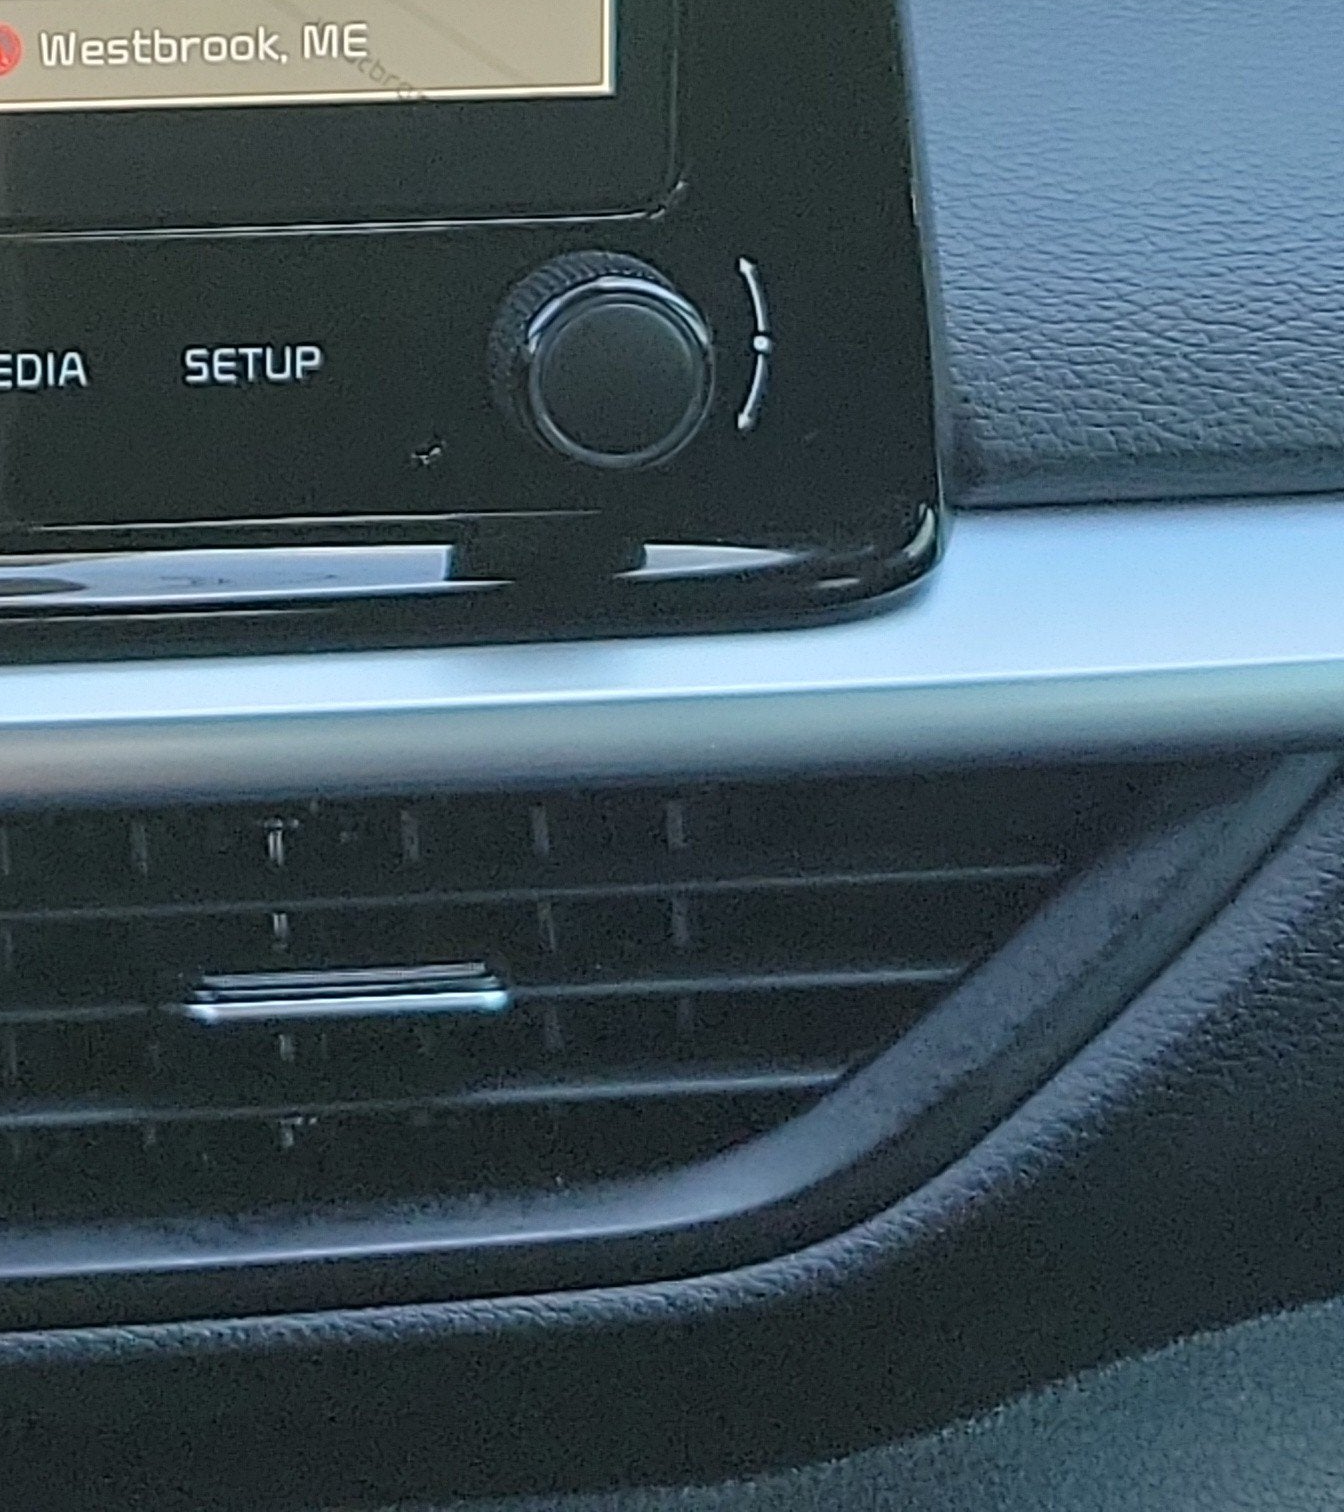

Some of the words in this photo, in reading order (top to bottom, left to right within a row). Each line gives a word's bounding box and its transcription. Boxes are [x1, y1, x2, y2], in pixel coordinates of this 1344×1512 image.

[41, 26, 288, 67] Westbrook,
[303, 23, 368, 59] ME
[185, 346, 321, 382] SETUP
